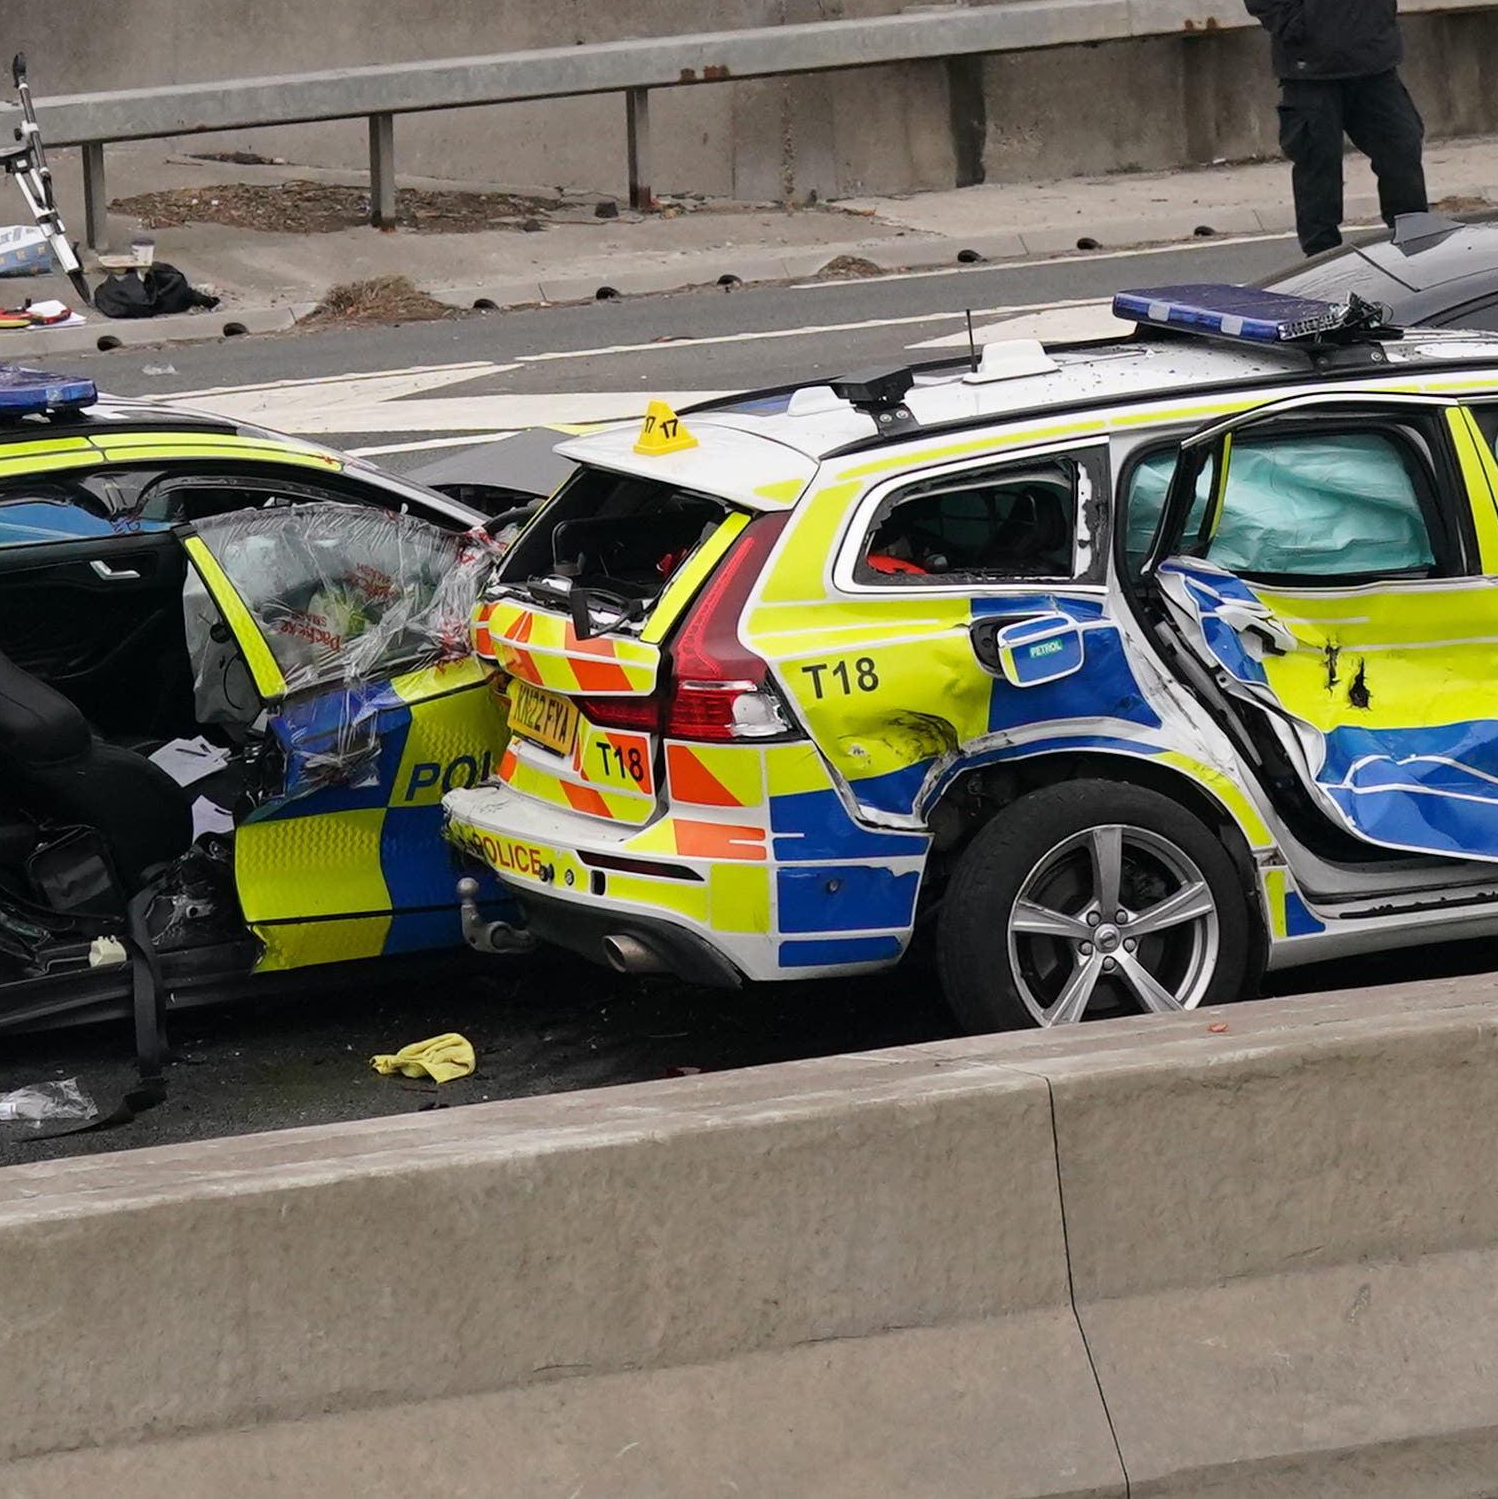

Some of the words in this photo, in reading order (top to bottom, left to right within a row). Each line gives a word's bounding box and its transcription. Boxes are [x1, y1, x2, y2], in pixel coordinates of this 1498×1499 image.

[645, 415, 656, 434] 17
[659, 418, 679, 439] 17
[1030, 641, 1063, 658] PETROL
[802, 656, 880, 700] T18
[543, 699, 571, 745] FYA
[595, 741, 645, 782] T18
[472, 833, 542, 876] POLICE
